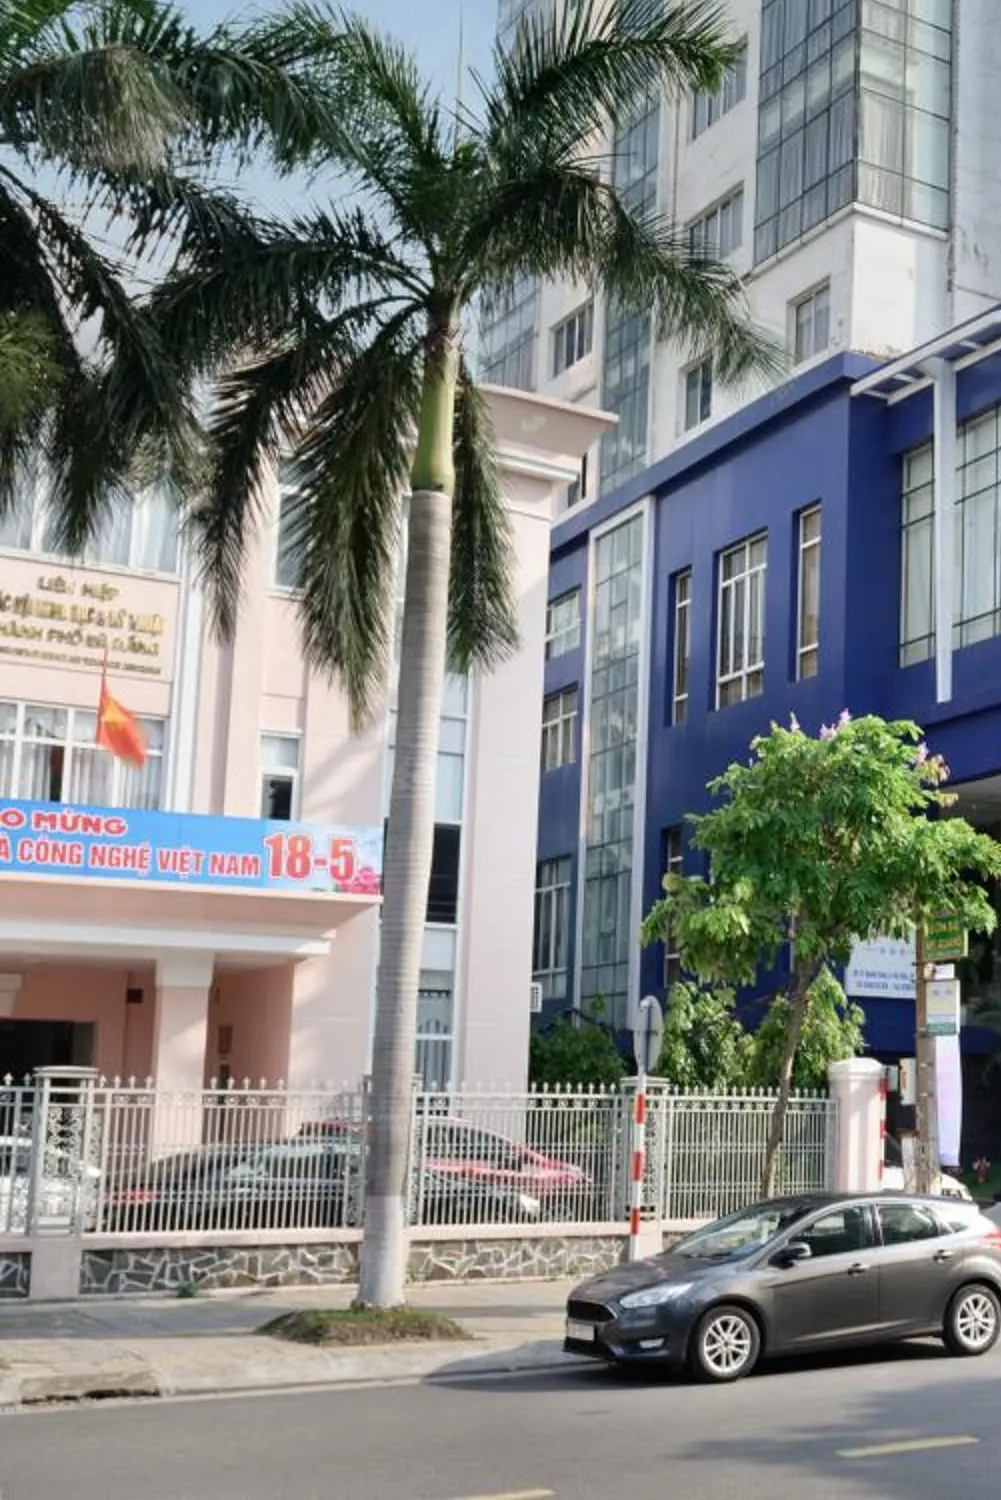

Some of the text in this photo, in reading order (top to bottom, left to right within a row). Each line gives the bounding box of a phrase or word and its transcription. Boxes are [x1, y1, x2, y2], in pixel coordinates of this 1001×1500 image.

[33, 808, 128, 836] MỪNG
[18, 834, 83, 866] CÔNG
[90, 841, 150, 878] NGHỆ
[158, 845, 204, 879] VIỆT
[210, 853, 260, 877] NAM
[264, 833, 356, 883] 18-5
